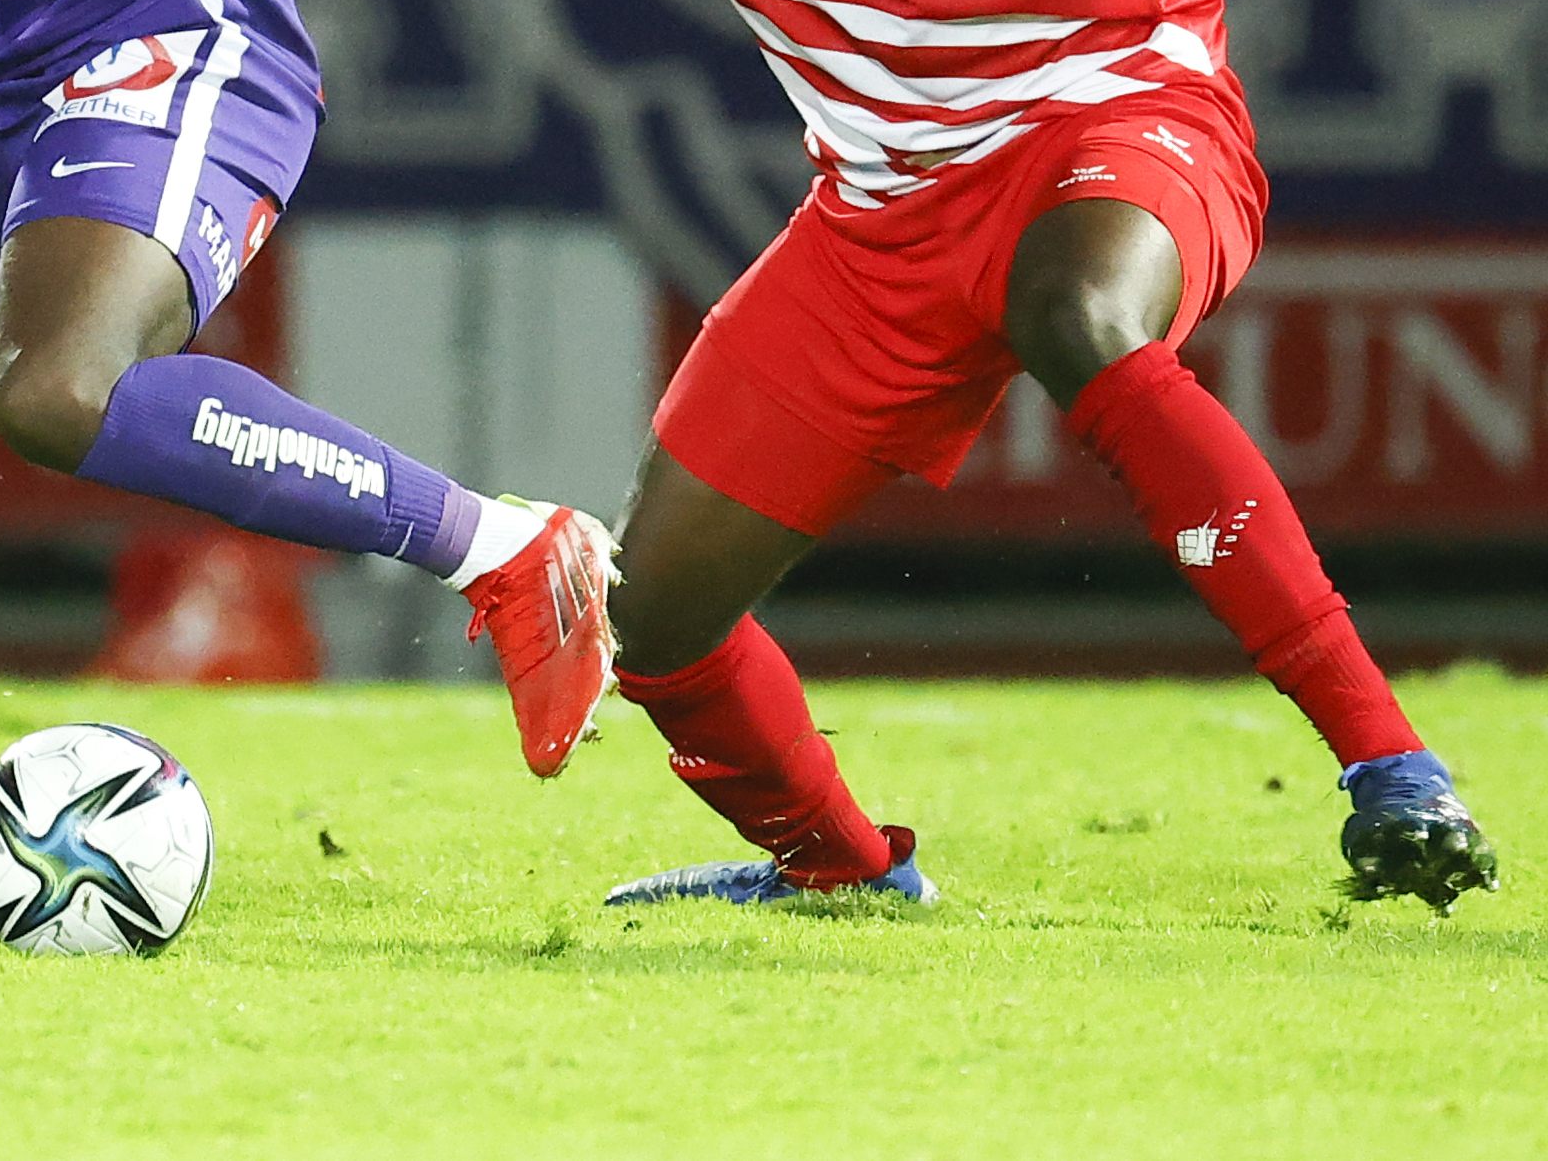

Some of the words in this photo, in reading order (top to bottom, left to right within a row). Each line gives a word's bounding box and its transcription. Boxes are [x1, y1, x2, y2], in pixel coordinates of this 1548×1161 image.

[57, 95, 158, 125] EITHER
[1056, 173, 1117, 189] erima
[192, 396, 388, 499] wienholding
